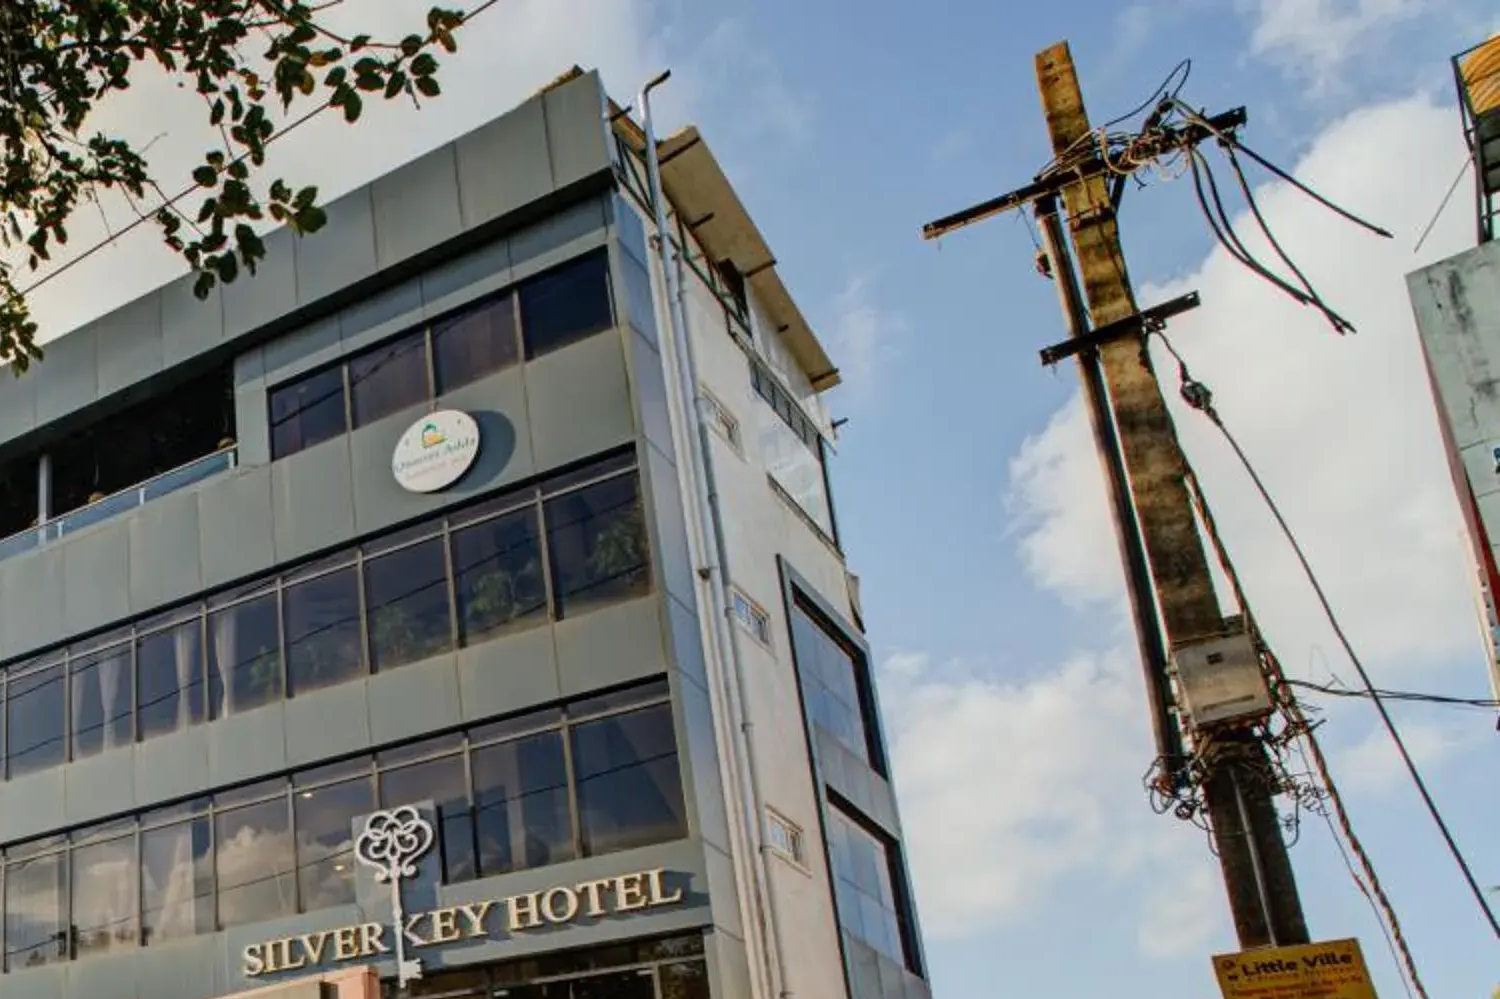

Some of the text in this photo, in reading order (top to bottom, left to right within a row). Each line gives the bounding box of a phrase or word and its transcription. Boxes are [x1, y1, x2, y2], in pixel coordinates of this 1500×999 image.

[241, 867, 682, 977] SILVER KEY HOTEL
[1242, 959, 1298, 977] Little
[1302, 951, 1353, 968] Ville
